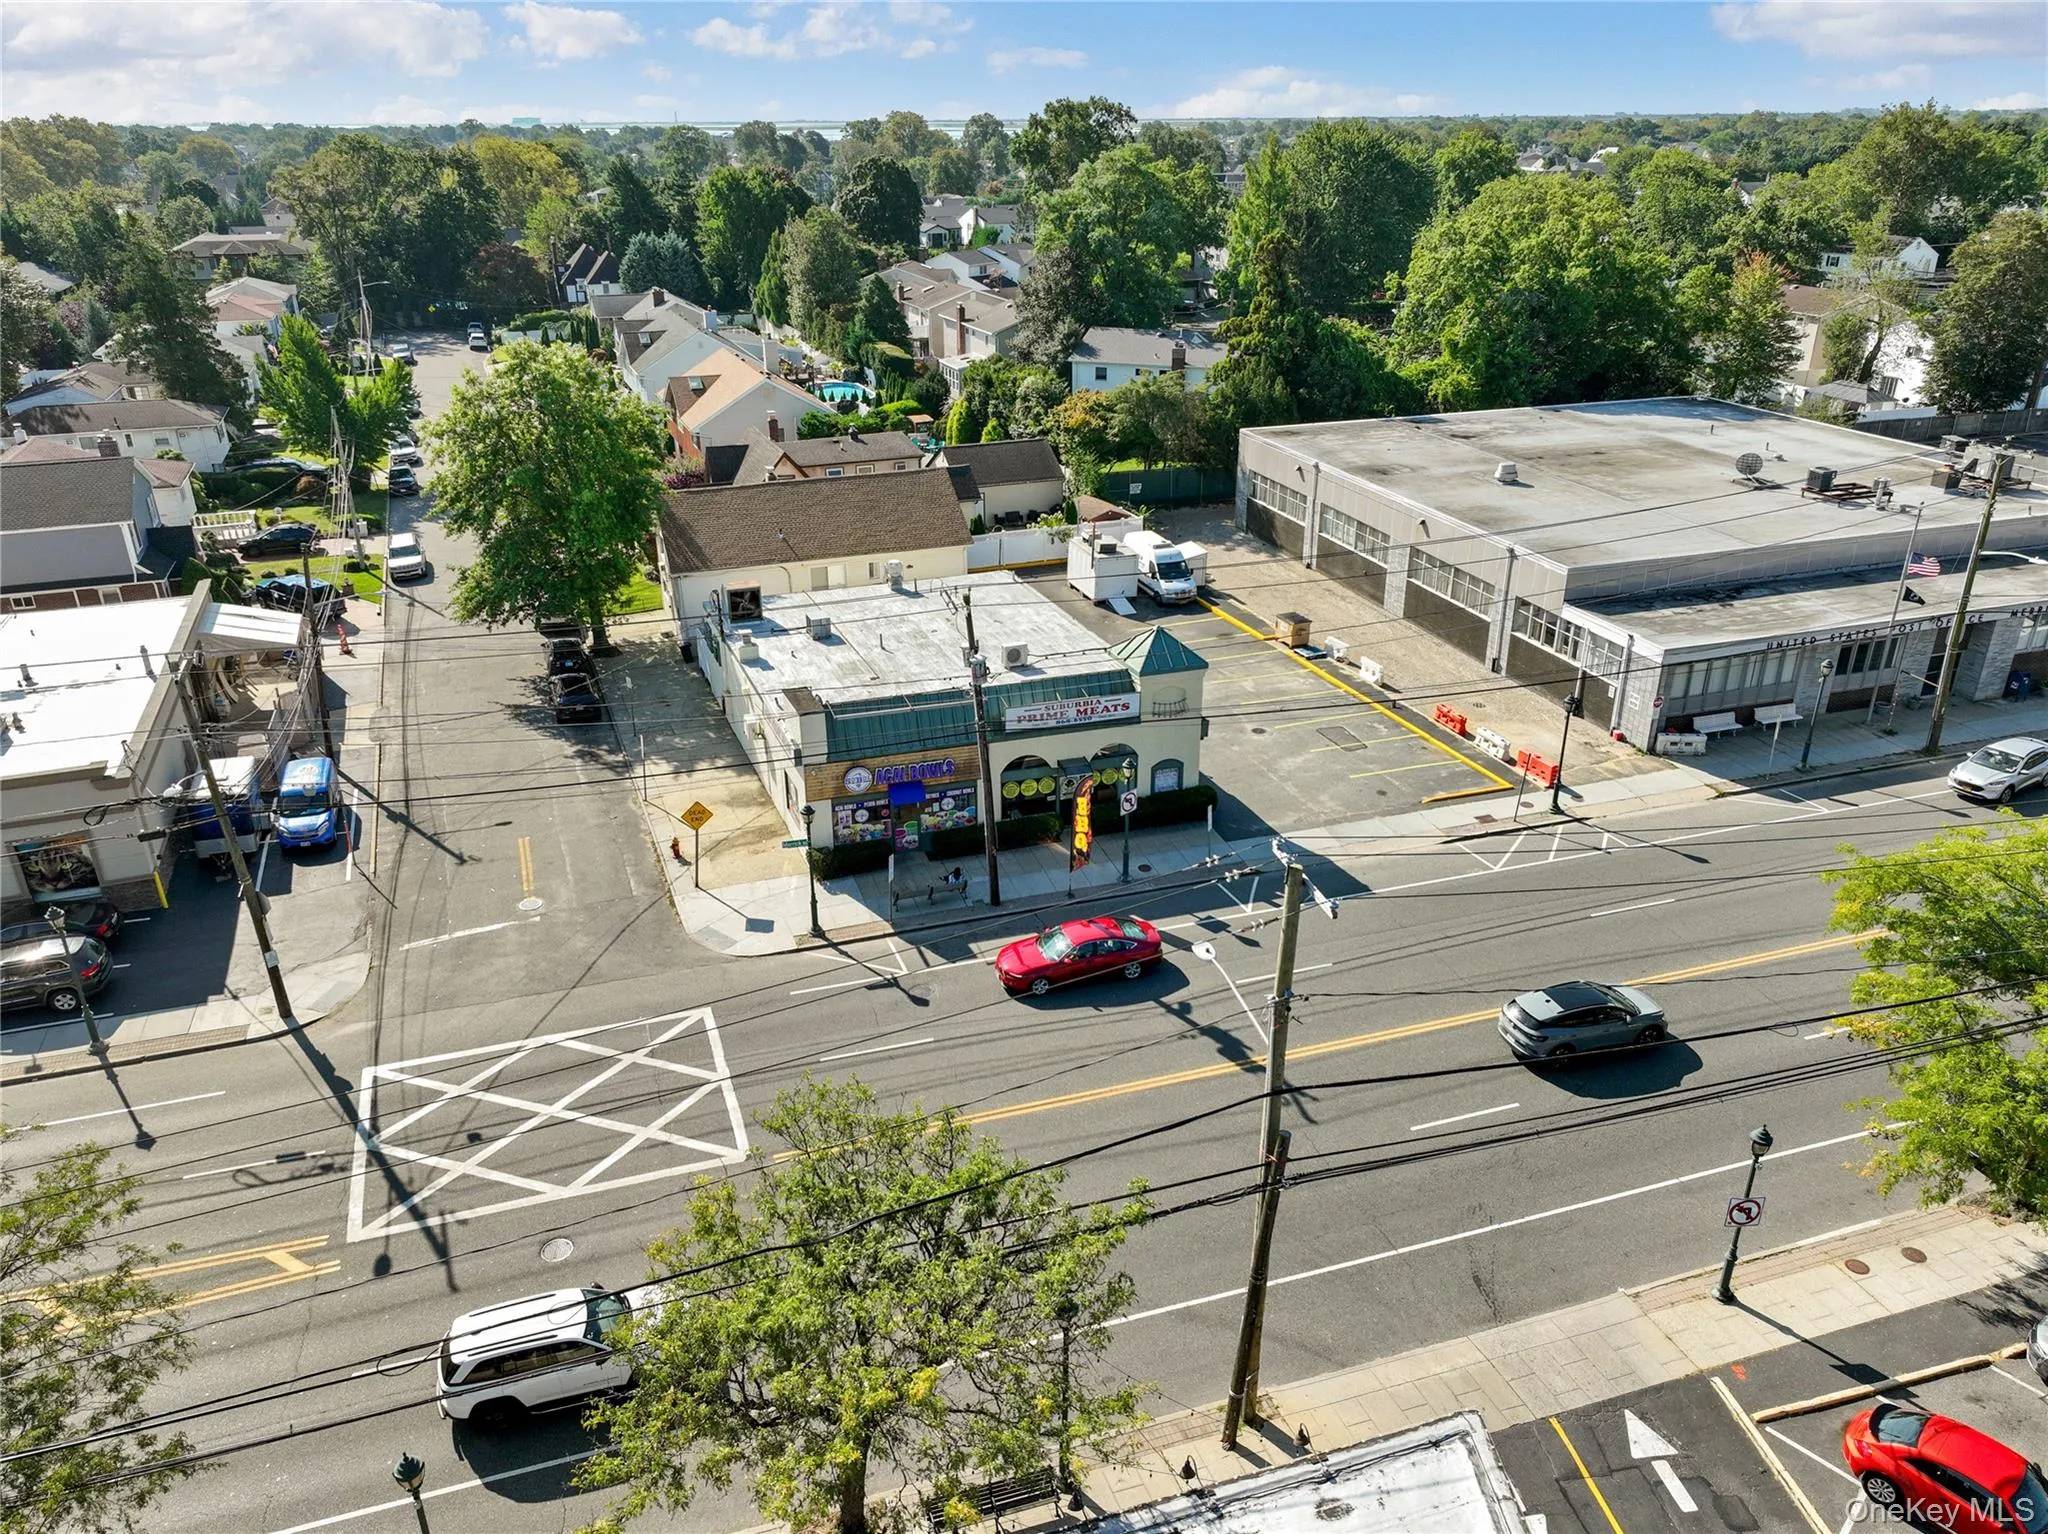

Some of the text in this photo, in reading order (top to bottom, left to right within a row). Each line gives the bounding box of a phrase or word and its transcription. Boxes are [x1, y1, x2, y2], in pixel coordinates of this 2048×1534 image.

[1766, 636, 1817, 651] UNITED
[1829, 628, 1877, 642] STATES
[1936, 614, 1985, 629] OFCE
[1016, 709, 1069, 724] PRIME
[1075, 702, 1130, 717] MEATS
[1044, 699, 1102, 712] SUBURBIA
[909, 758, 955, 781] BOWLS
[1074, 796, 1089, 853] BBQ
